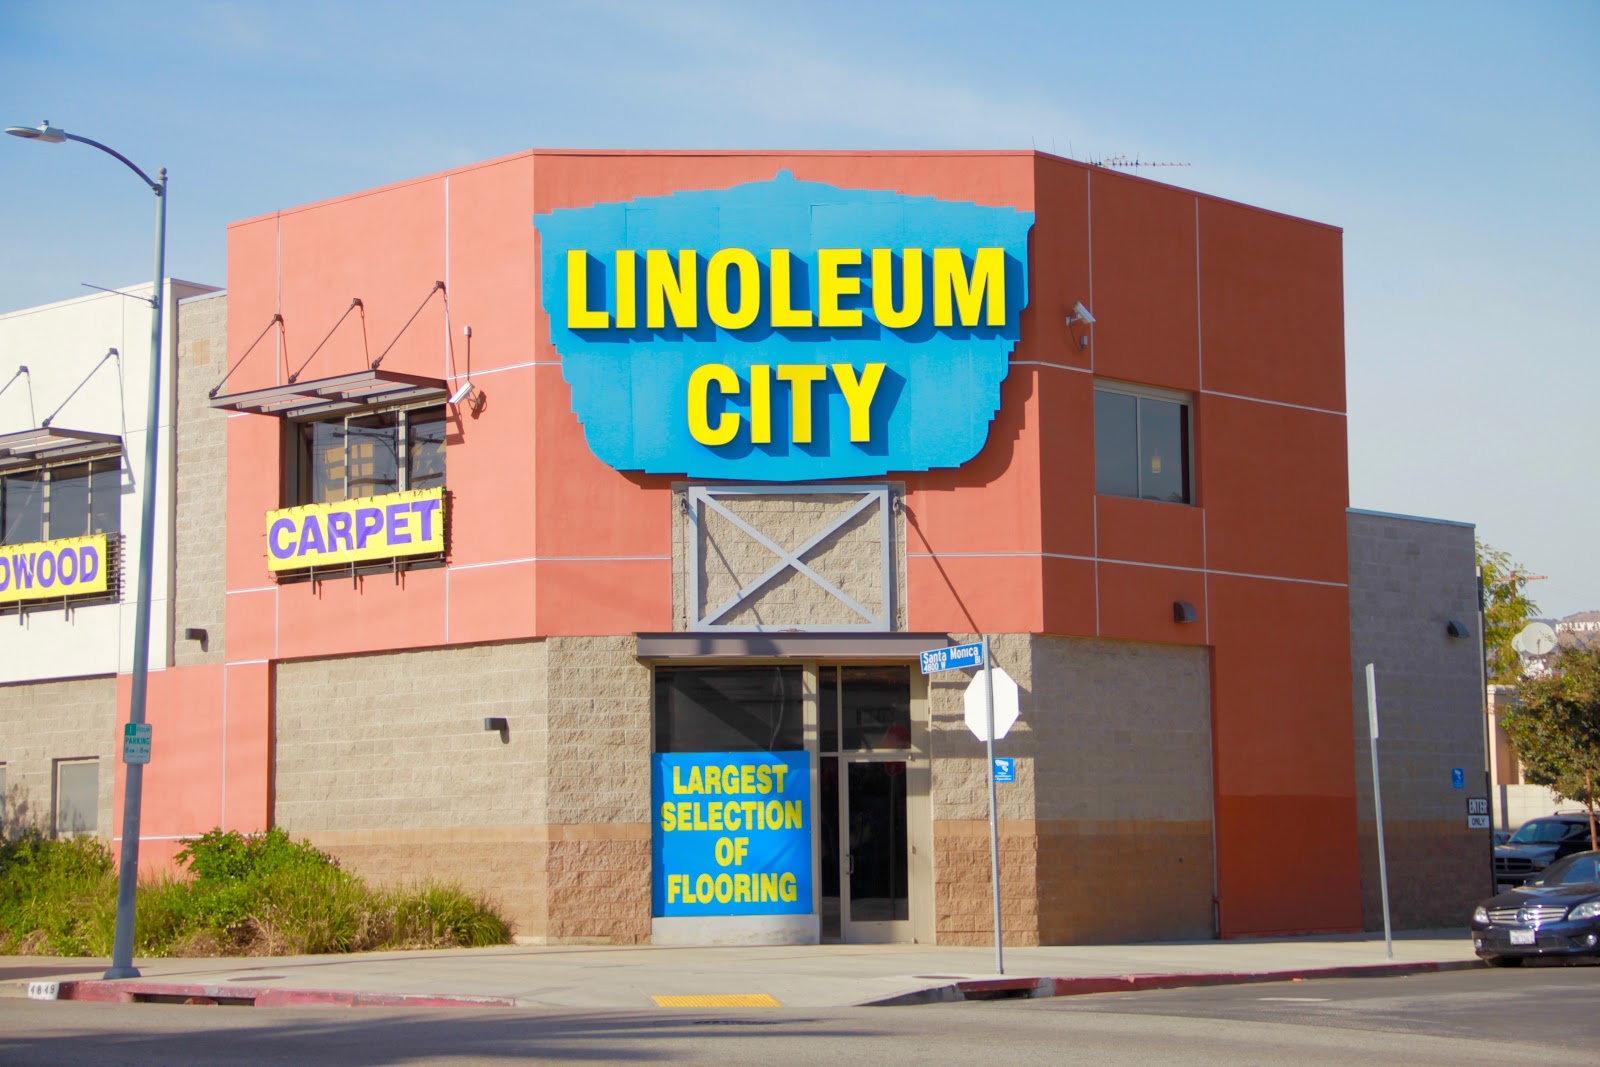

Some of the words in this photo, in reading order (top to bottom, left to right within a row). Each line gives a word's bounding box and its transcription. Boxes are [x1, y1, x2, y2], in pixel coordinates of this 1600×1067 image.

[567, 247, 1006, 329] LINOLEUM
[687, 362, 887, 445] CITY
[269, 499, 440, 559] CARPET
[924, 651, 946, 664] Santa
[950, 646, 978, 660] Monica
[924, 663, 939, 672] 4800
[941, 661, 946, 669] W
[673, 764, 788, 795] LARGEST
[660, 800, 803, 832] SELECTION
[1469, 799, 1487, 814] ENTER
[1471, 817, 1486, 826] ONLY
[715, 837, 749, 866] OF
[667, 872, 797, 904] FLOORING
[30, 984, 55, 995] 4849
